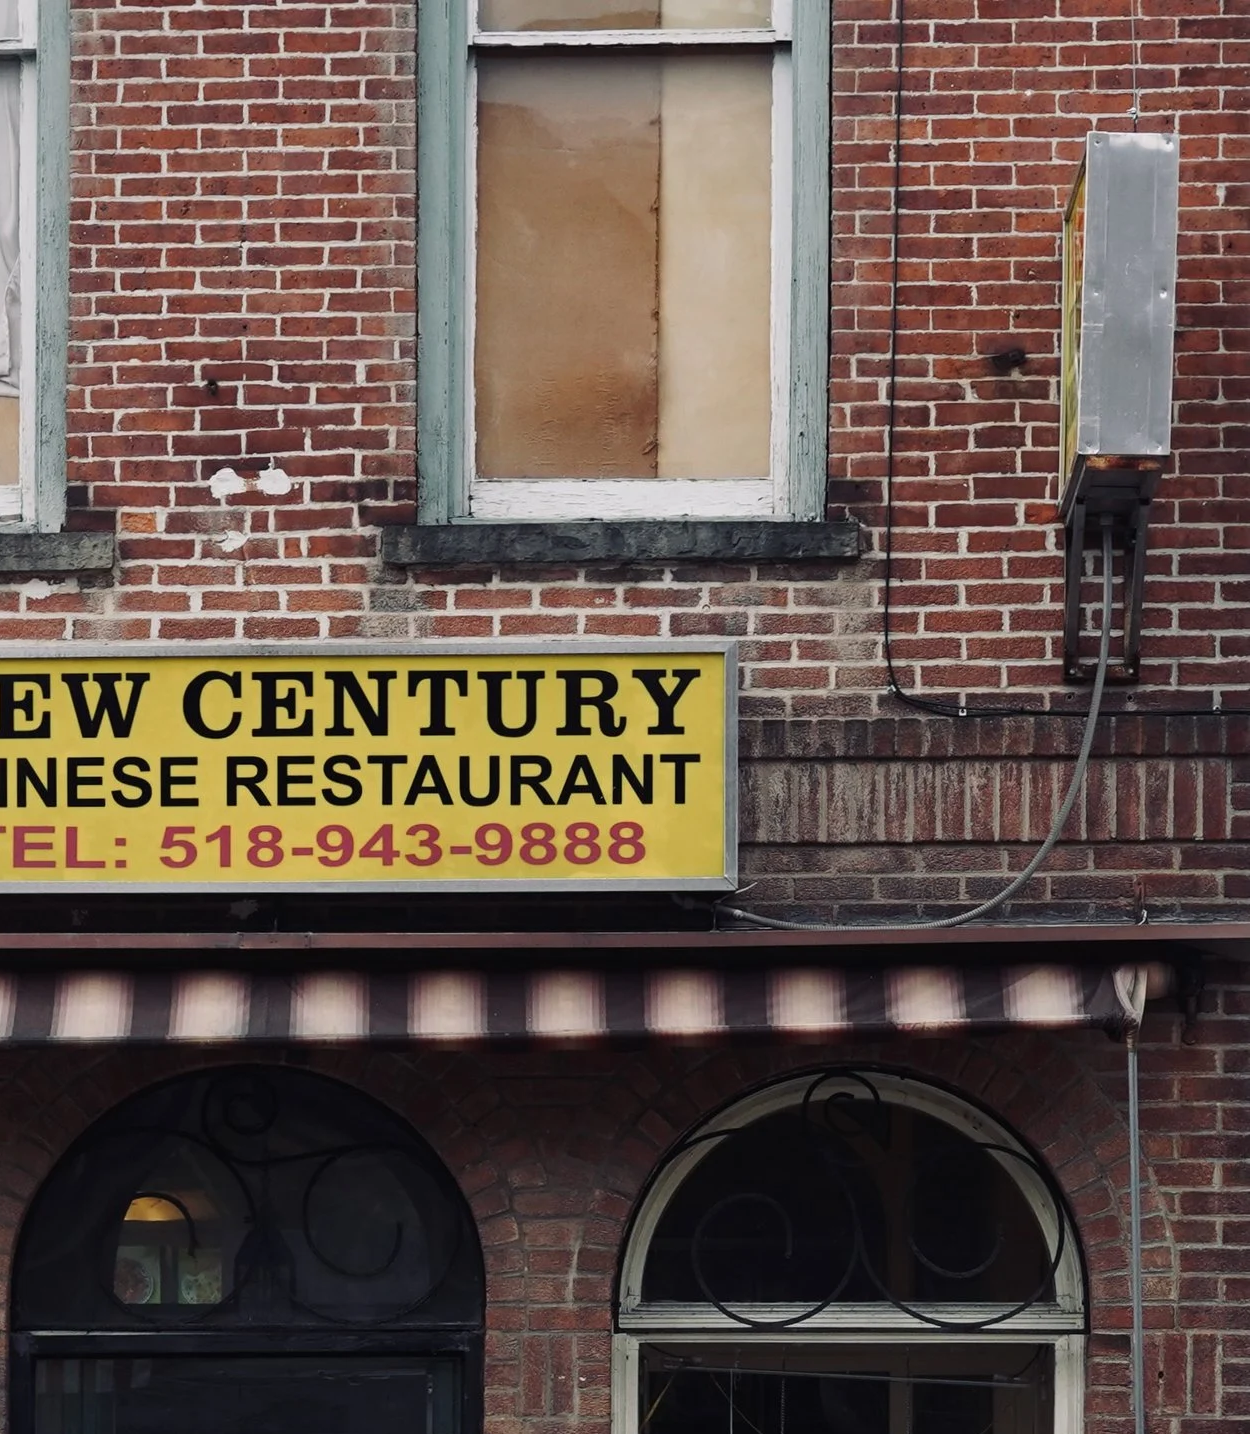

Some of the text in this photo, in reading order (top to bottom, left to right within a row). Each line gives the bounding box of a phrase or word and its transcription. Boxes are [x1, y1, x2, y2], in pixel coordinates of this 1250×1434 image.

[183, 669, 702, 739] CENTURY
[227, 754, 701, 807] RESTAURANT
[158, 819, 647, 870] 518-943-9888
